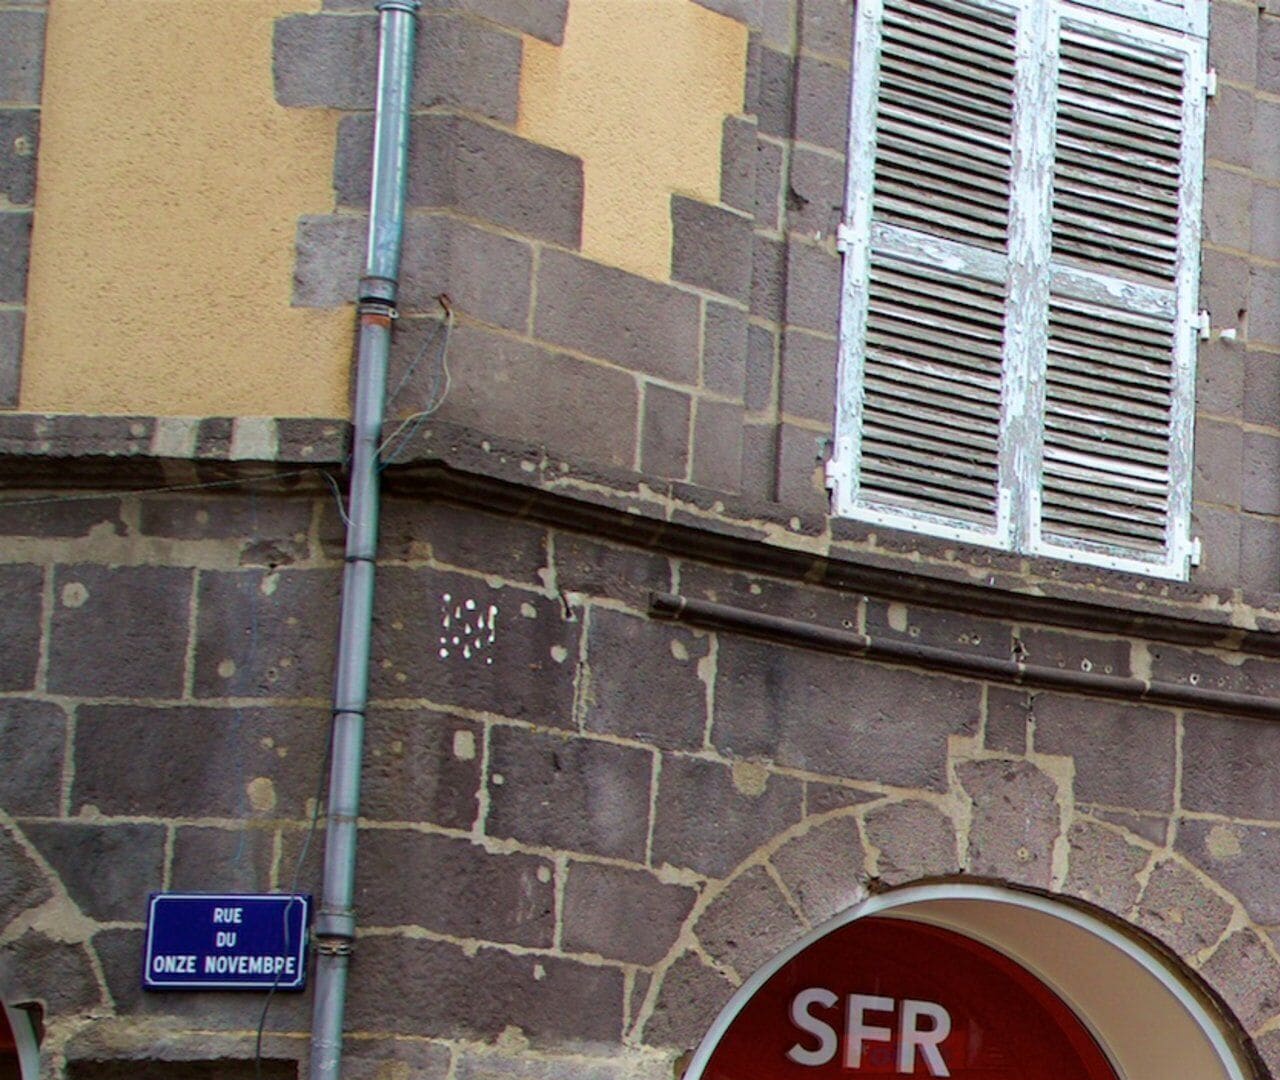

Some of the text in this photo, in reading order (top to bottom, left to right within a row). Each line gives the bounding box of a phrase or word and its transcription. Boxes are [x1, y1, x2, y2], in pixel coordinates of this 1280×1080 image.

[213, 907, 243, 924] RUE
[215, 931, 237, 948] DU
[152, 955, 296, 975] ONZE NOVEMBRE
[785, 987, 952, 1078] SFR
